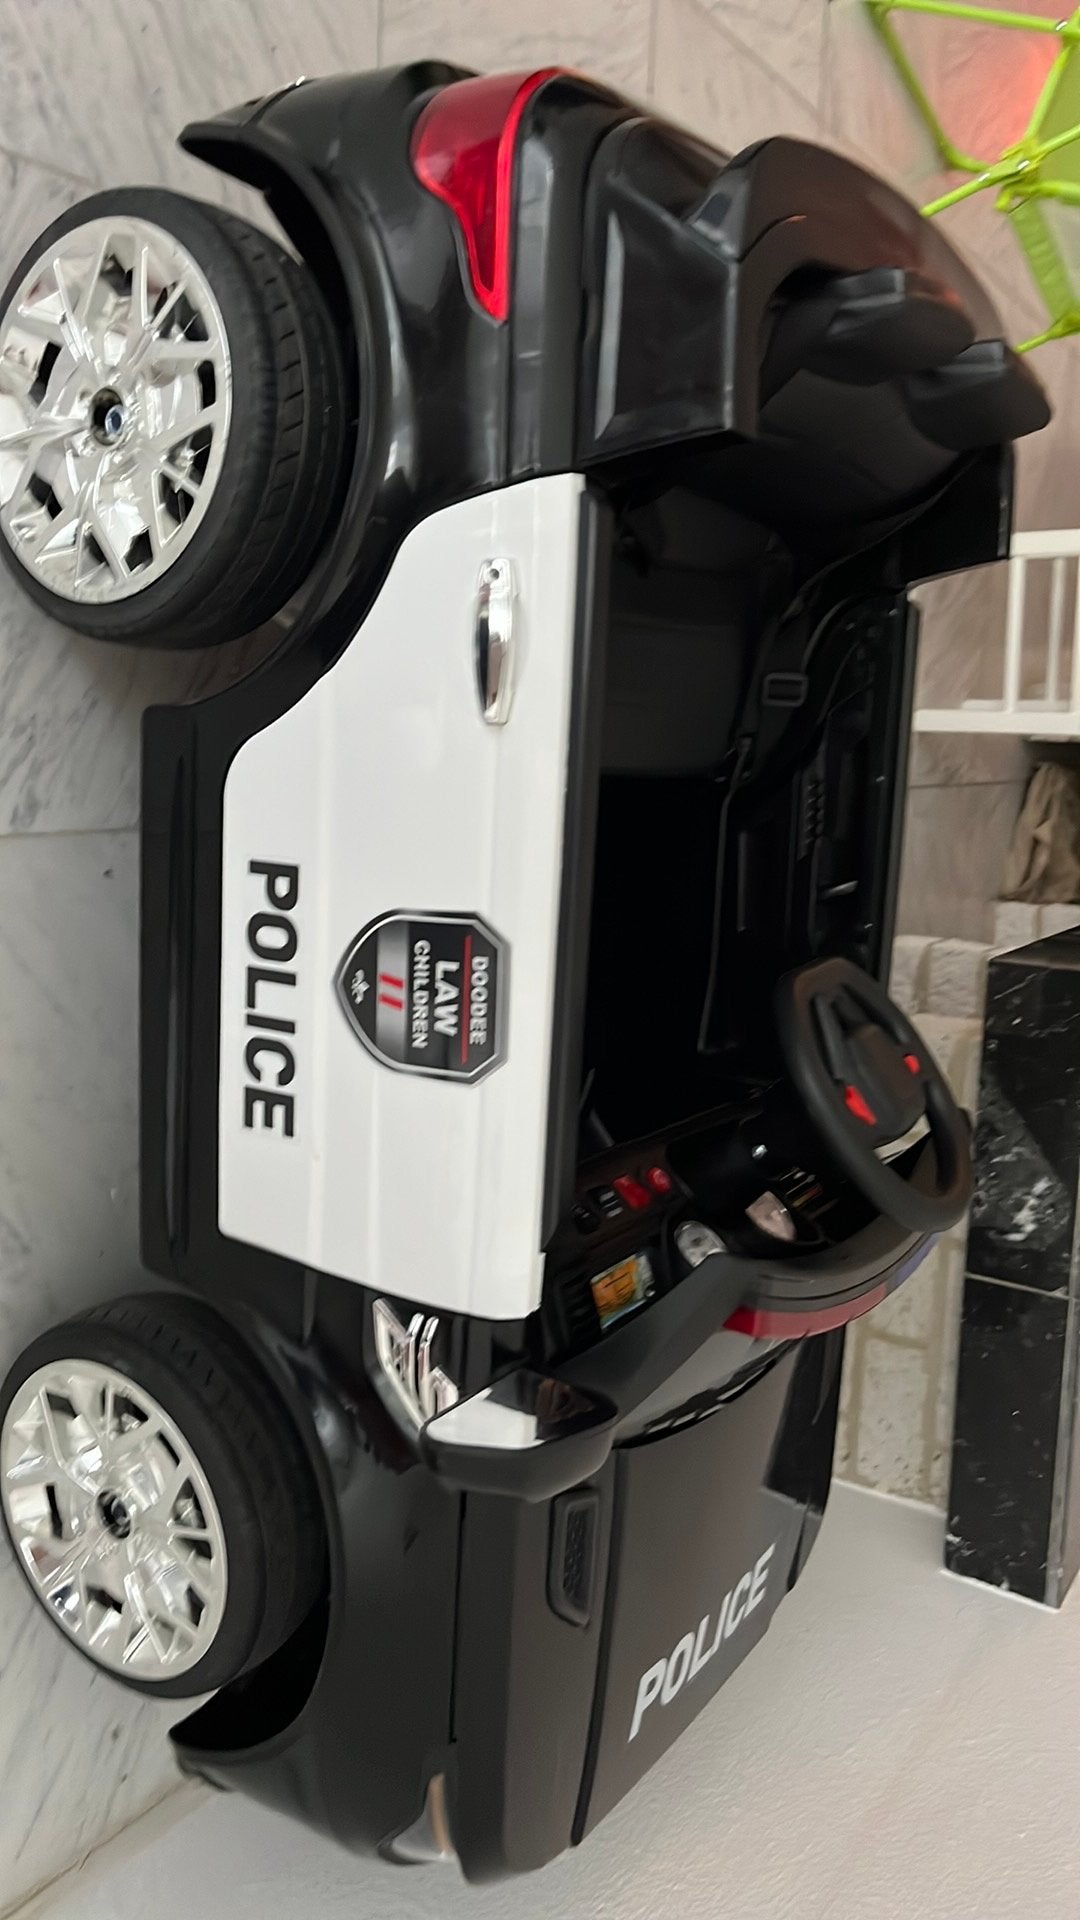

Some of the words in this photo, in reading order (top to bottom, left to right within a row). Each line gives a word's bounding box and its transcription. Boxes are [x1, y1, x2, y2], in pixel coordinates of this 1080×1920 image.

[244, 860, 299, 1137] POLICE
[412, 940, 431, 1049] CHILDREN
[434, 961, 460, 1036] LAW
[469, 956, 490, 1045] DOODEE
[627, 1543, 776, 1743] POLICE
